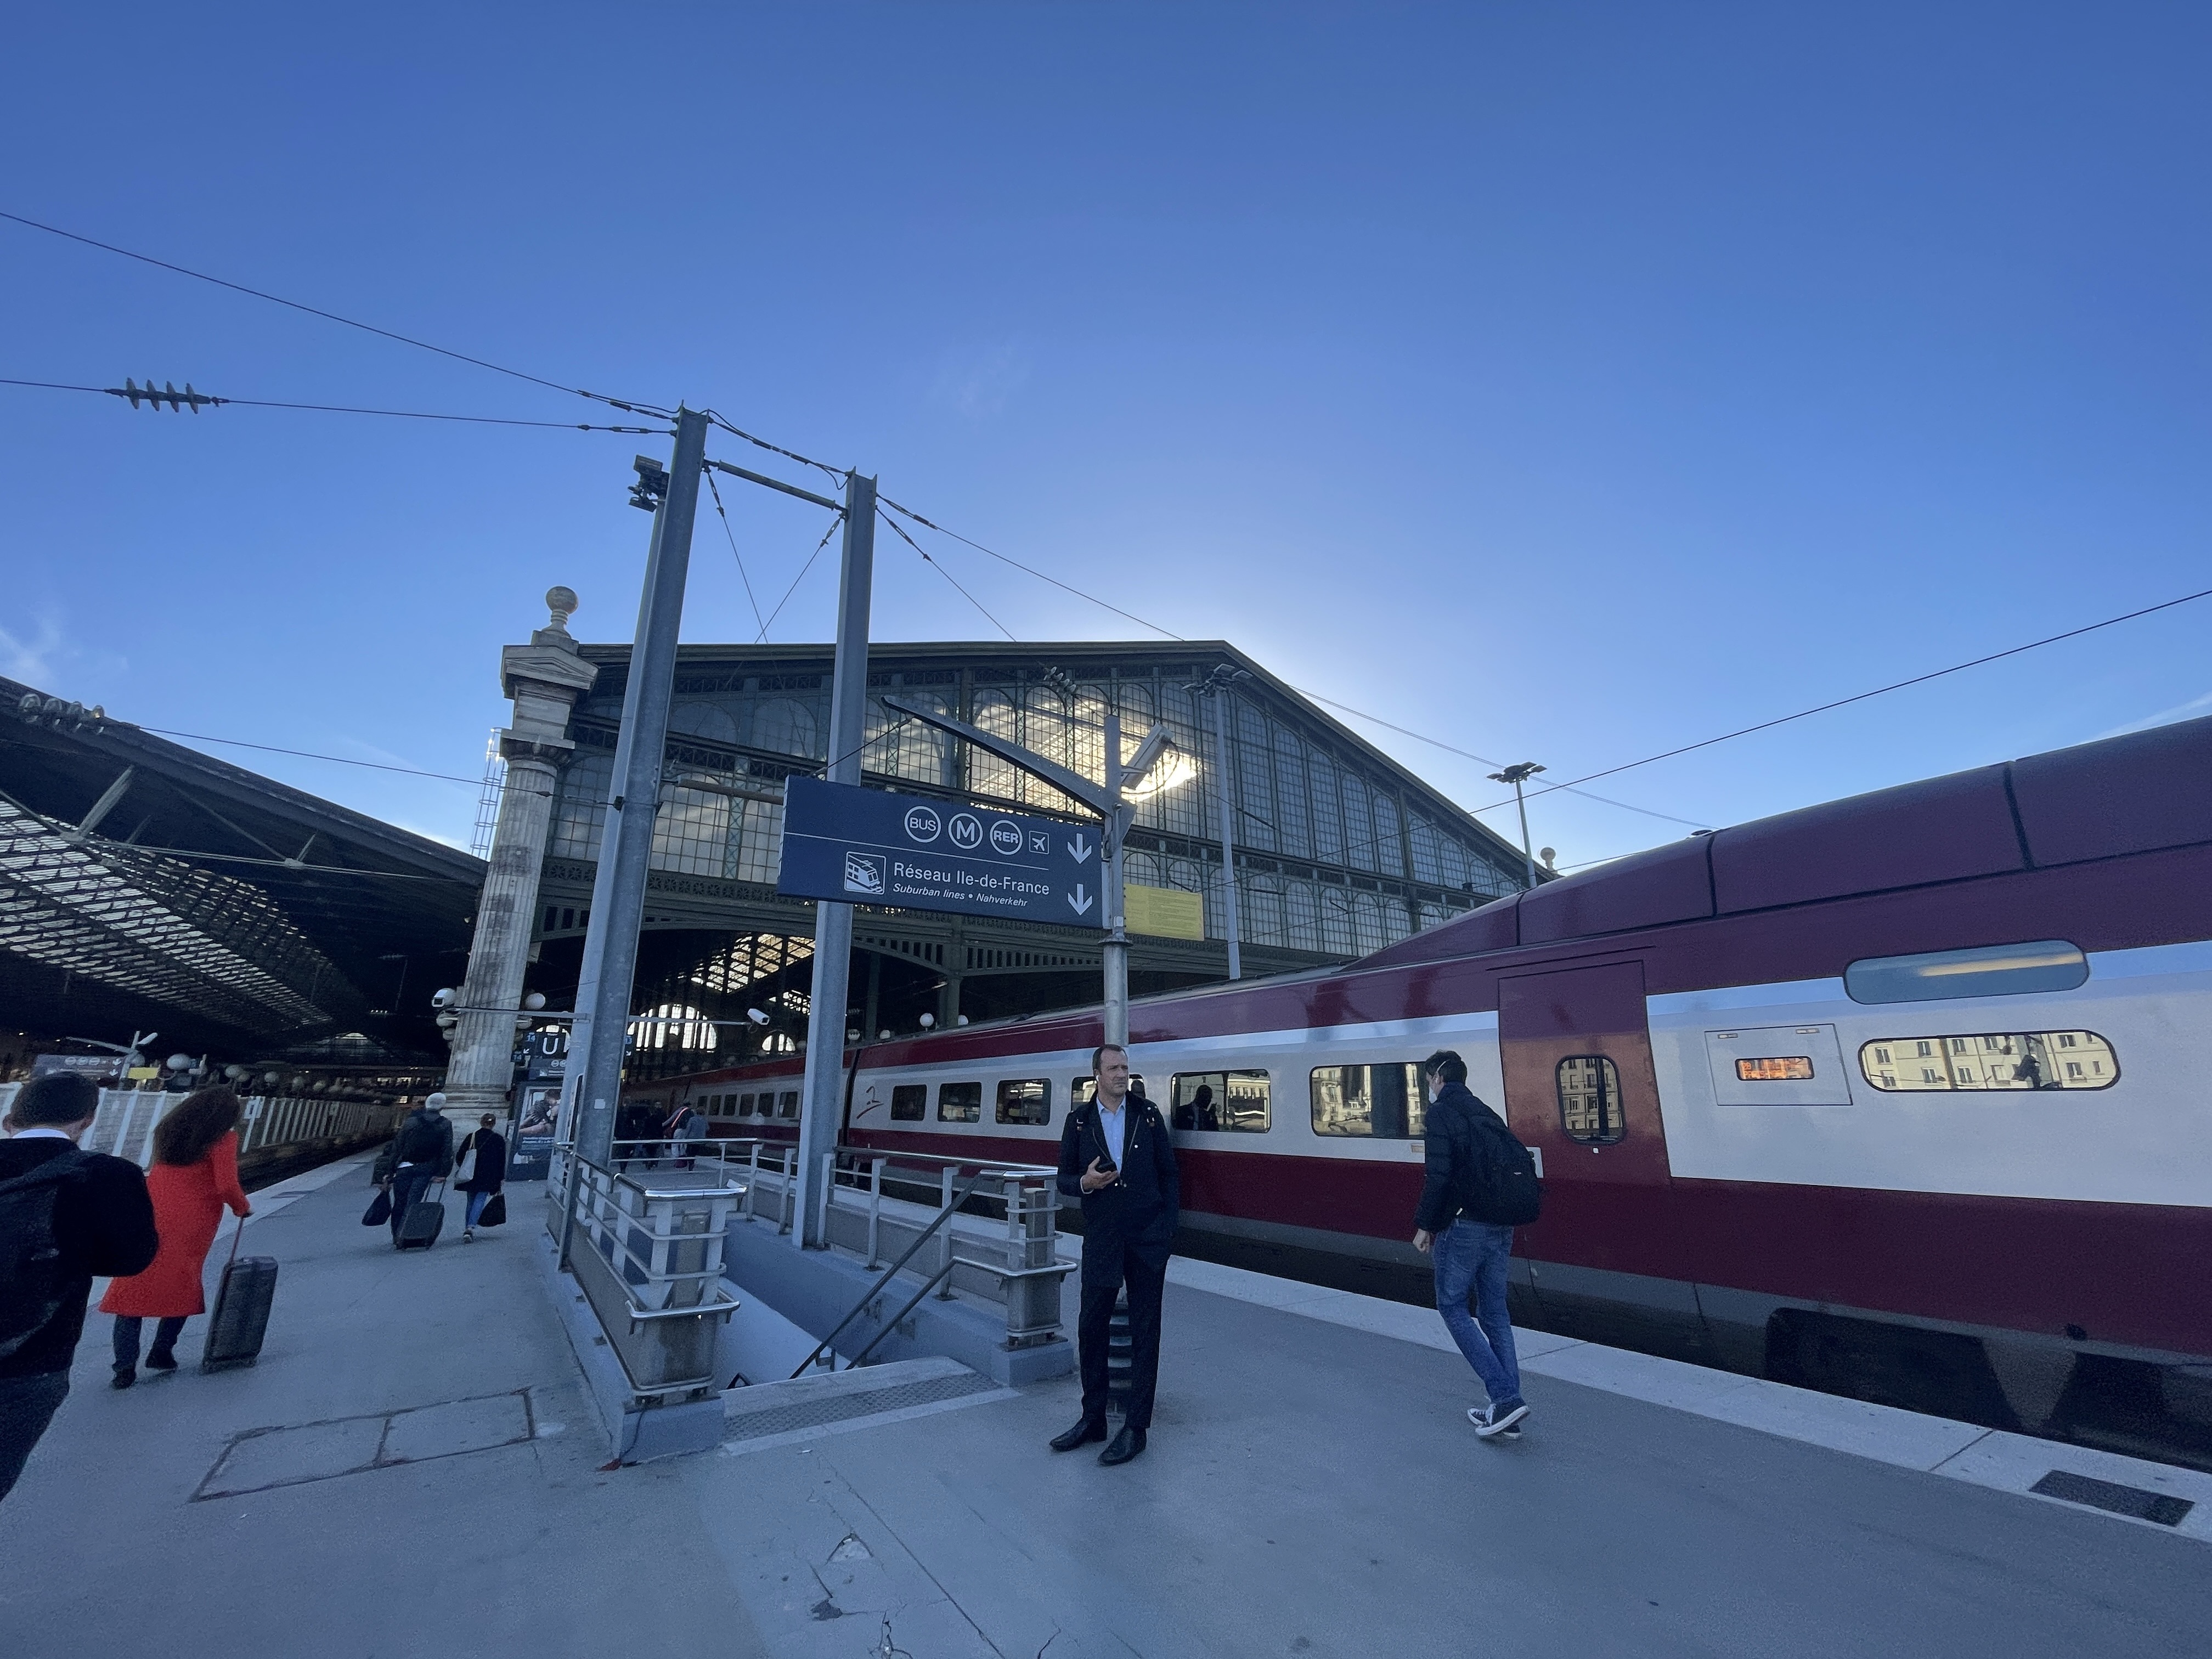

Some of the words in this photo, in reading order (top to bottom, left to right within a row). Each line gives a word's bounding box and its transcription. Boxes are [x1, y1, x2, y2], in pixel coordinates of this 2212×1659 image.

[909, 817, 936, 832] BUS
[956, 820, 975, 842] M
[993, 830, 1019, 844] RER
[893, 862, 951, 883] Réseau
[956, 870, 1050, 895] Ile-de-France
[893, 883, 940, 898] Suburban
[943, 889, 966, 900] lines
[975, 893, 1028, 907] Nahverkehr
[542, 1037, 560, 1055] U
